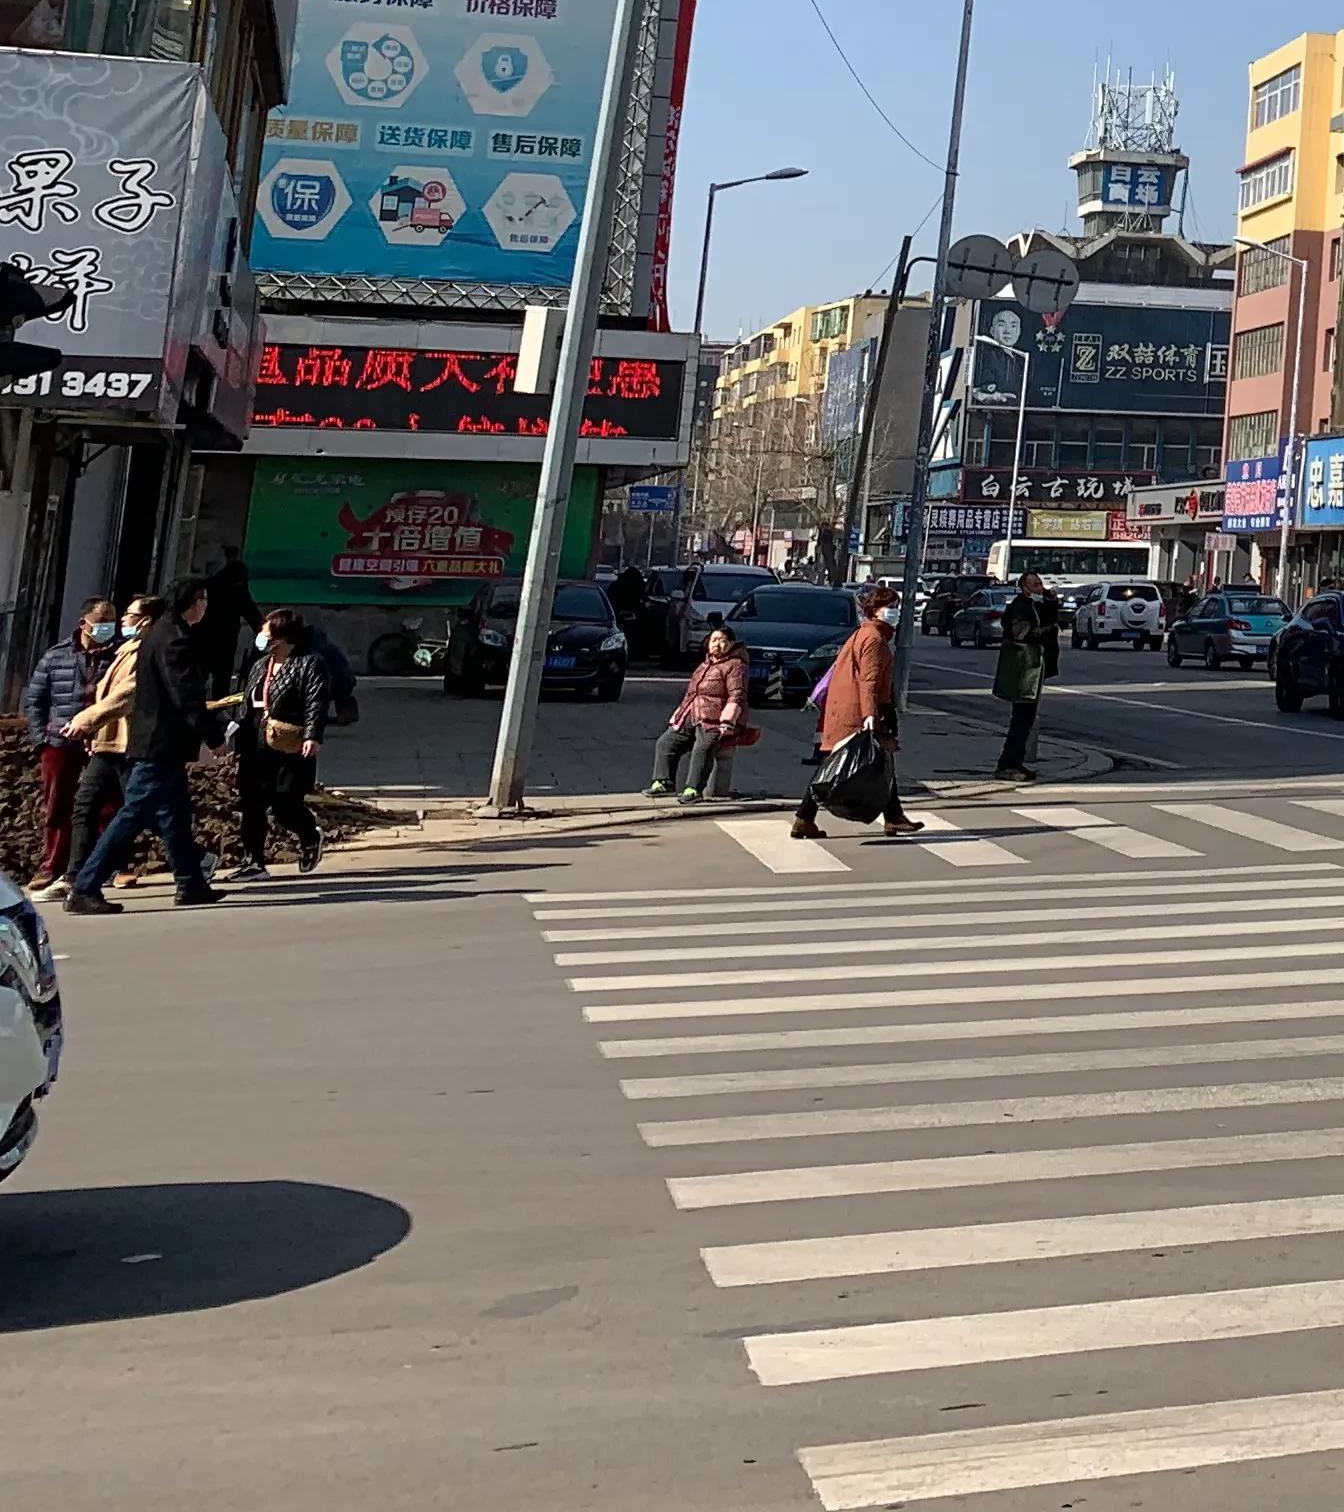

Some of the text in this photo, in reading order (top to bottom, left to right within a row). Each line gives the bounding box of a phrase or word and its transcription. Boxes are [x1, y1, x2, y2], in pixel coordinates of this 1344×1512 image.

[378, 125, 473, 151] 送货保障
[491, 133, 583, 159] 售后保障
[1110, 165, 1161, 183] 白云
[0, 150, 175, 233] 果子
[283, 180, 321, 211] 保
[61, 371, 153, 399] 3437
[1105, 366, 1127, 380] ZZ
[1131, 367, 1198, 382] SPORTS
[981, 474, 1136, 499] 白云古玩城
